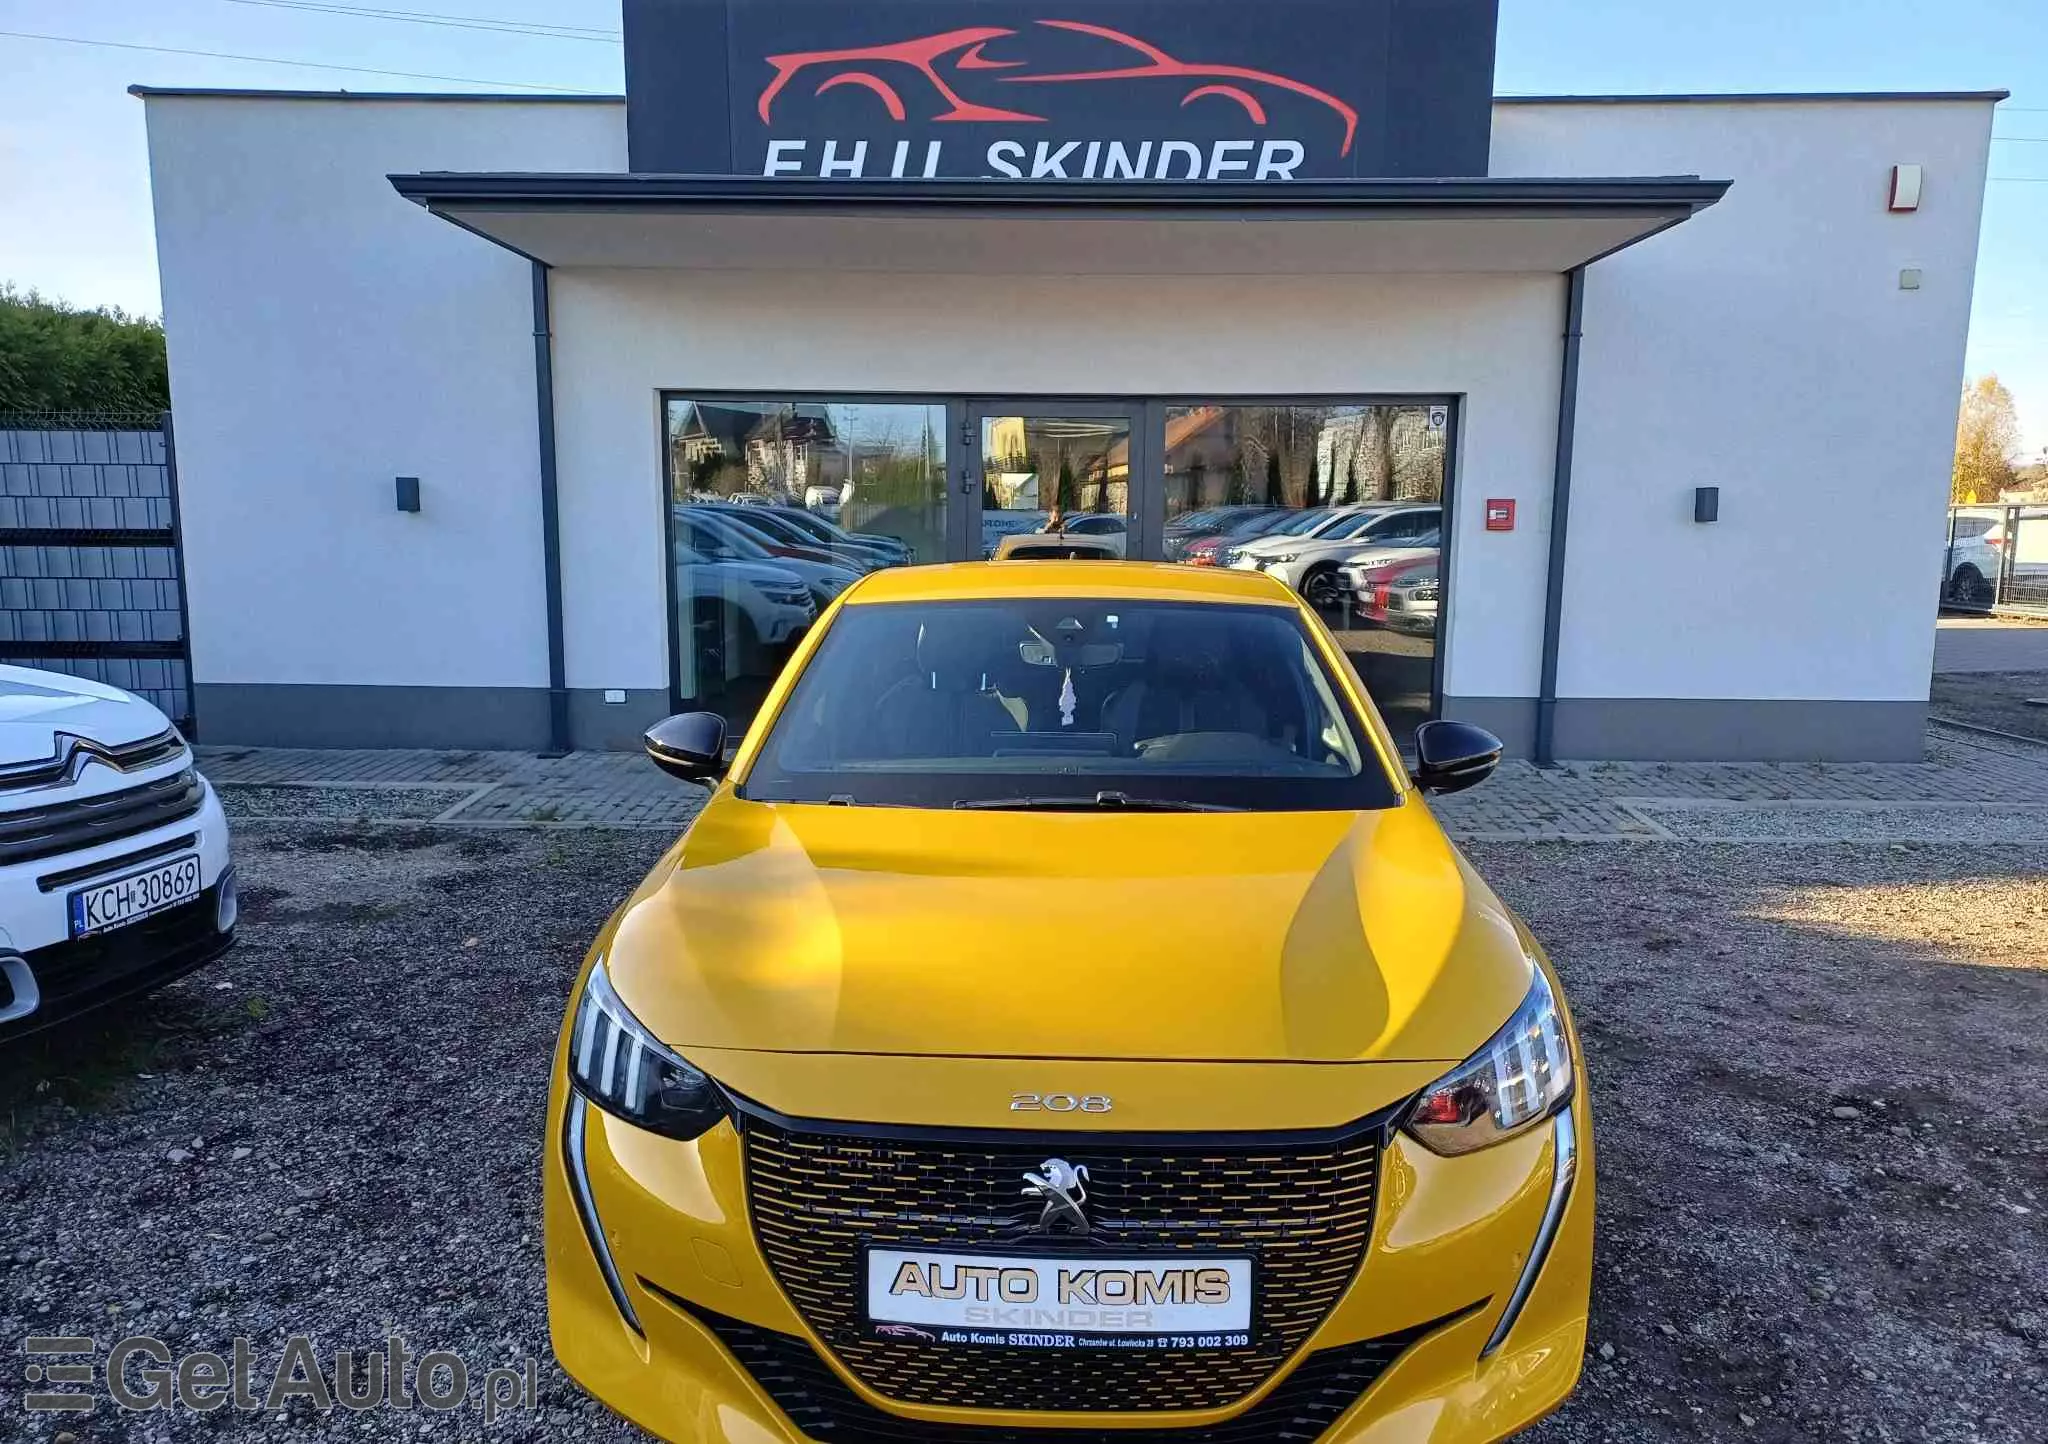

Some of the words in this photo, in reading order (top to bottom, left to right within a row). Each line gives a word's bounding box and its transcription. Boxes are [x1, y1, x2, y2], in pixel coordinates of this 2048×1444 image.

[986, 140, 1305, 180] SKINDER
[86, 883, 131, 928] KCH
[137, 862, 196, 909] 30869
[1010, 1094, 1113, 1113] 208
[889, 1261, 1039, 1303] AUTO
[1058, 1268, 1231, 1306] KOMIS
[964, 1306, 1154, 1328] SKINDER
[942, 1331, 968, 1344] Auto
[970, 1333, 1005, 1345] Komis
[1008, 1333, 1076, 1347] SKINDER
[1171, 1336, 1194, 1348] 793
[1198, 1335, 1221, 1347] 002
[1225, 1334, 1248, 1346] 309
